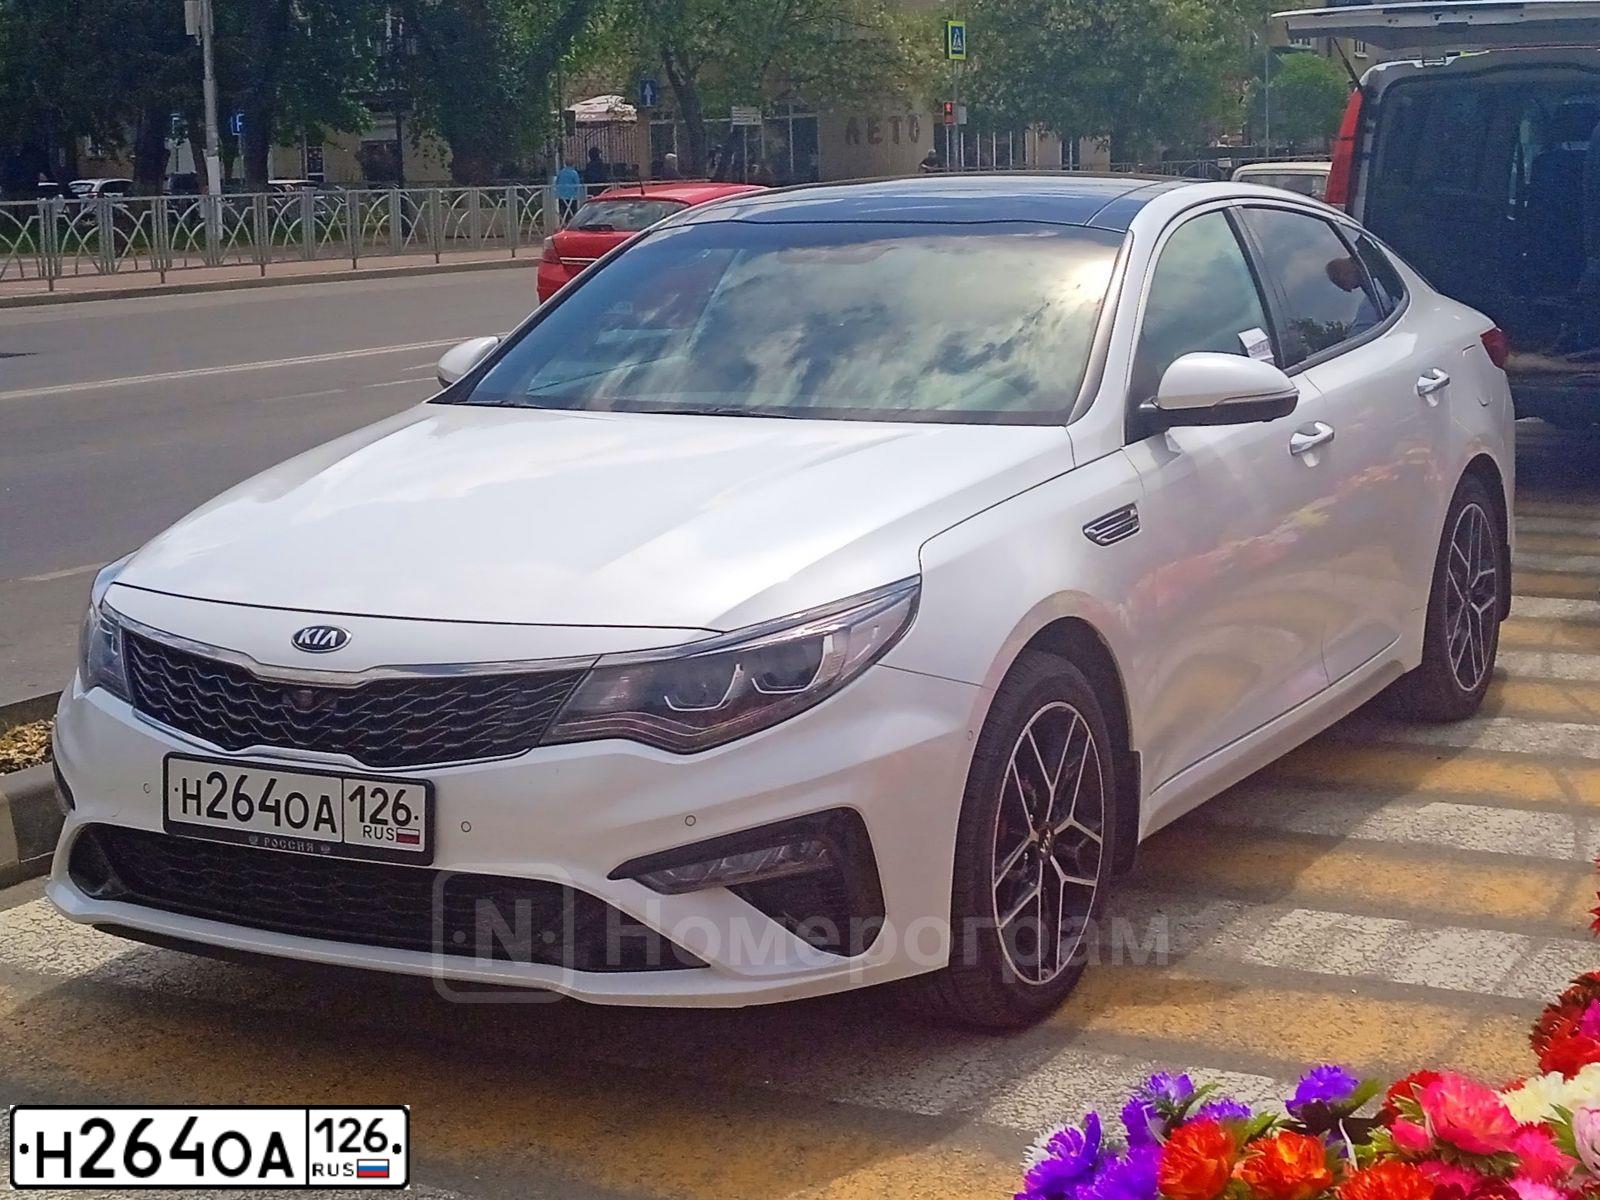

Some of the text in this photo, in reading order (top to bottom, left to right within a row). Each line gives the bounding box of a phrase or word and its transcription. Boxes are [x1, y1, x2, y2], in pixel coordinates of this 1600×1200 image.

[297, 628, 338, 647] KIA
[348, 785, 412, 826] 126
[362, 825, 395, 841] RUS
[264, 836, 315, 853] РОССИЯ
